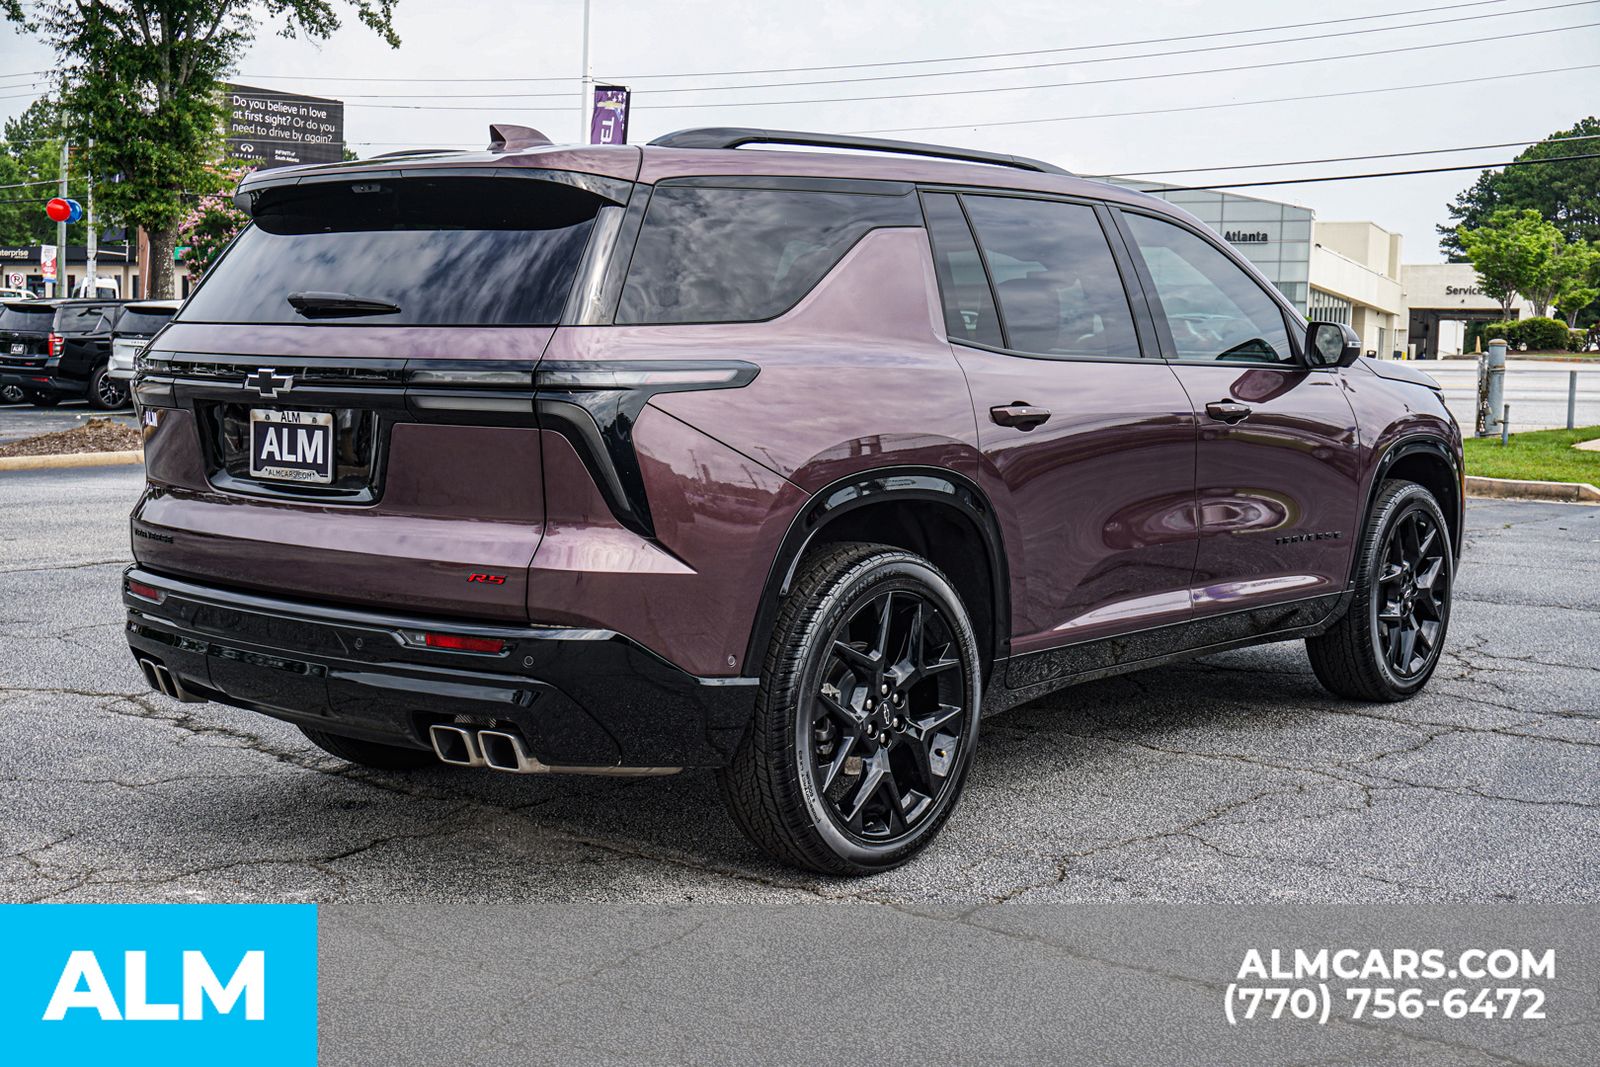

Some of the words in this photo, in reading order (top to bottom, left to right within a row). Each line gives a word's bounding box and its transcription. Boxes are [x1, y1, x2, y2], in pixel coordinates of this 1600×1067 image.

[233, 95, 247, 107] Do
[248, 100, 265, 110] you
[267, 101, 298, 115] believe
[299, 105, 307, 116] in
[309, 106, 327, 119] love
[232, 110, 242, 119] at
[245, 110, 263, 122] first
[264, 114, 291, 127] sight?
[293, 117, 305, 128] Or
[306, 120, 318, 130] do
[319, 123, 336, 133] you
[232, 123, 254, 134] need
[257, 125, 267, 136] to
[269, 127, 291, 139] drive
[292, 130, 303, 142] by
[304, 133, 333, 145] again?
[1224, 230, 1268, 242] Atlanta
[281, 411, 301, 423] ALM
[260, 426, 323, 464] ALM
[467, 572, 508, 585] RS
